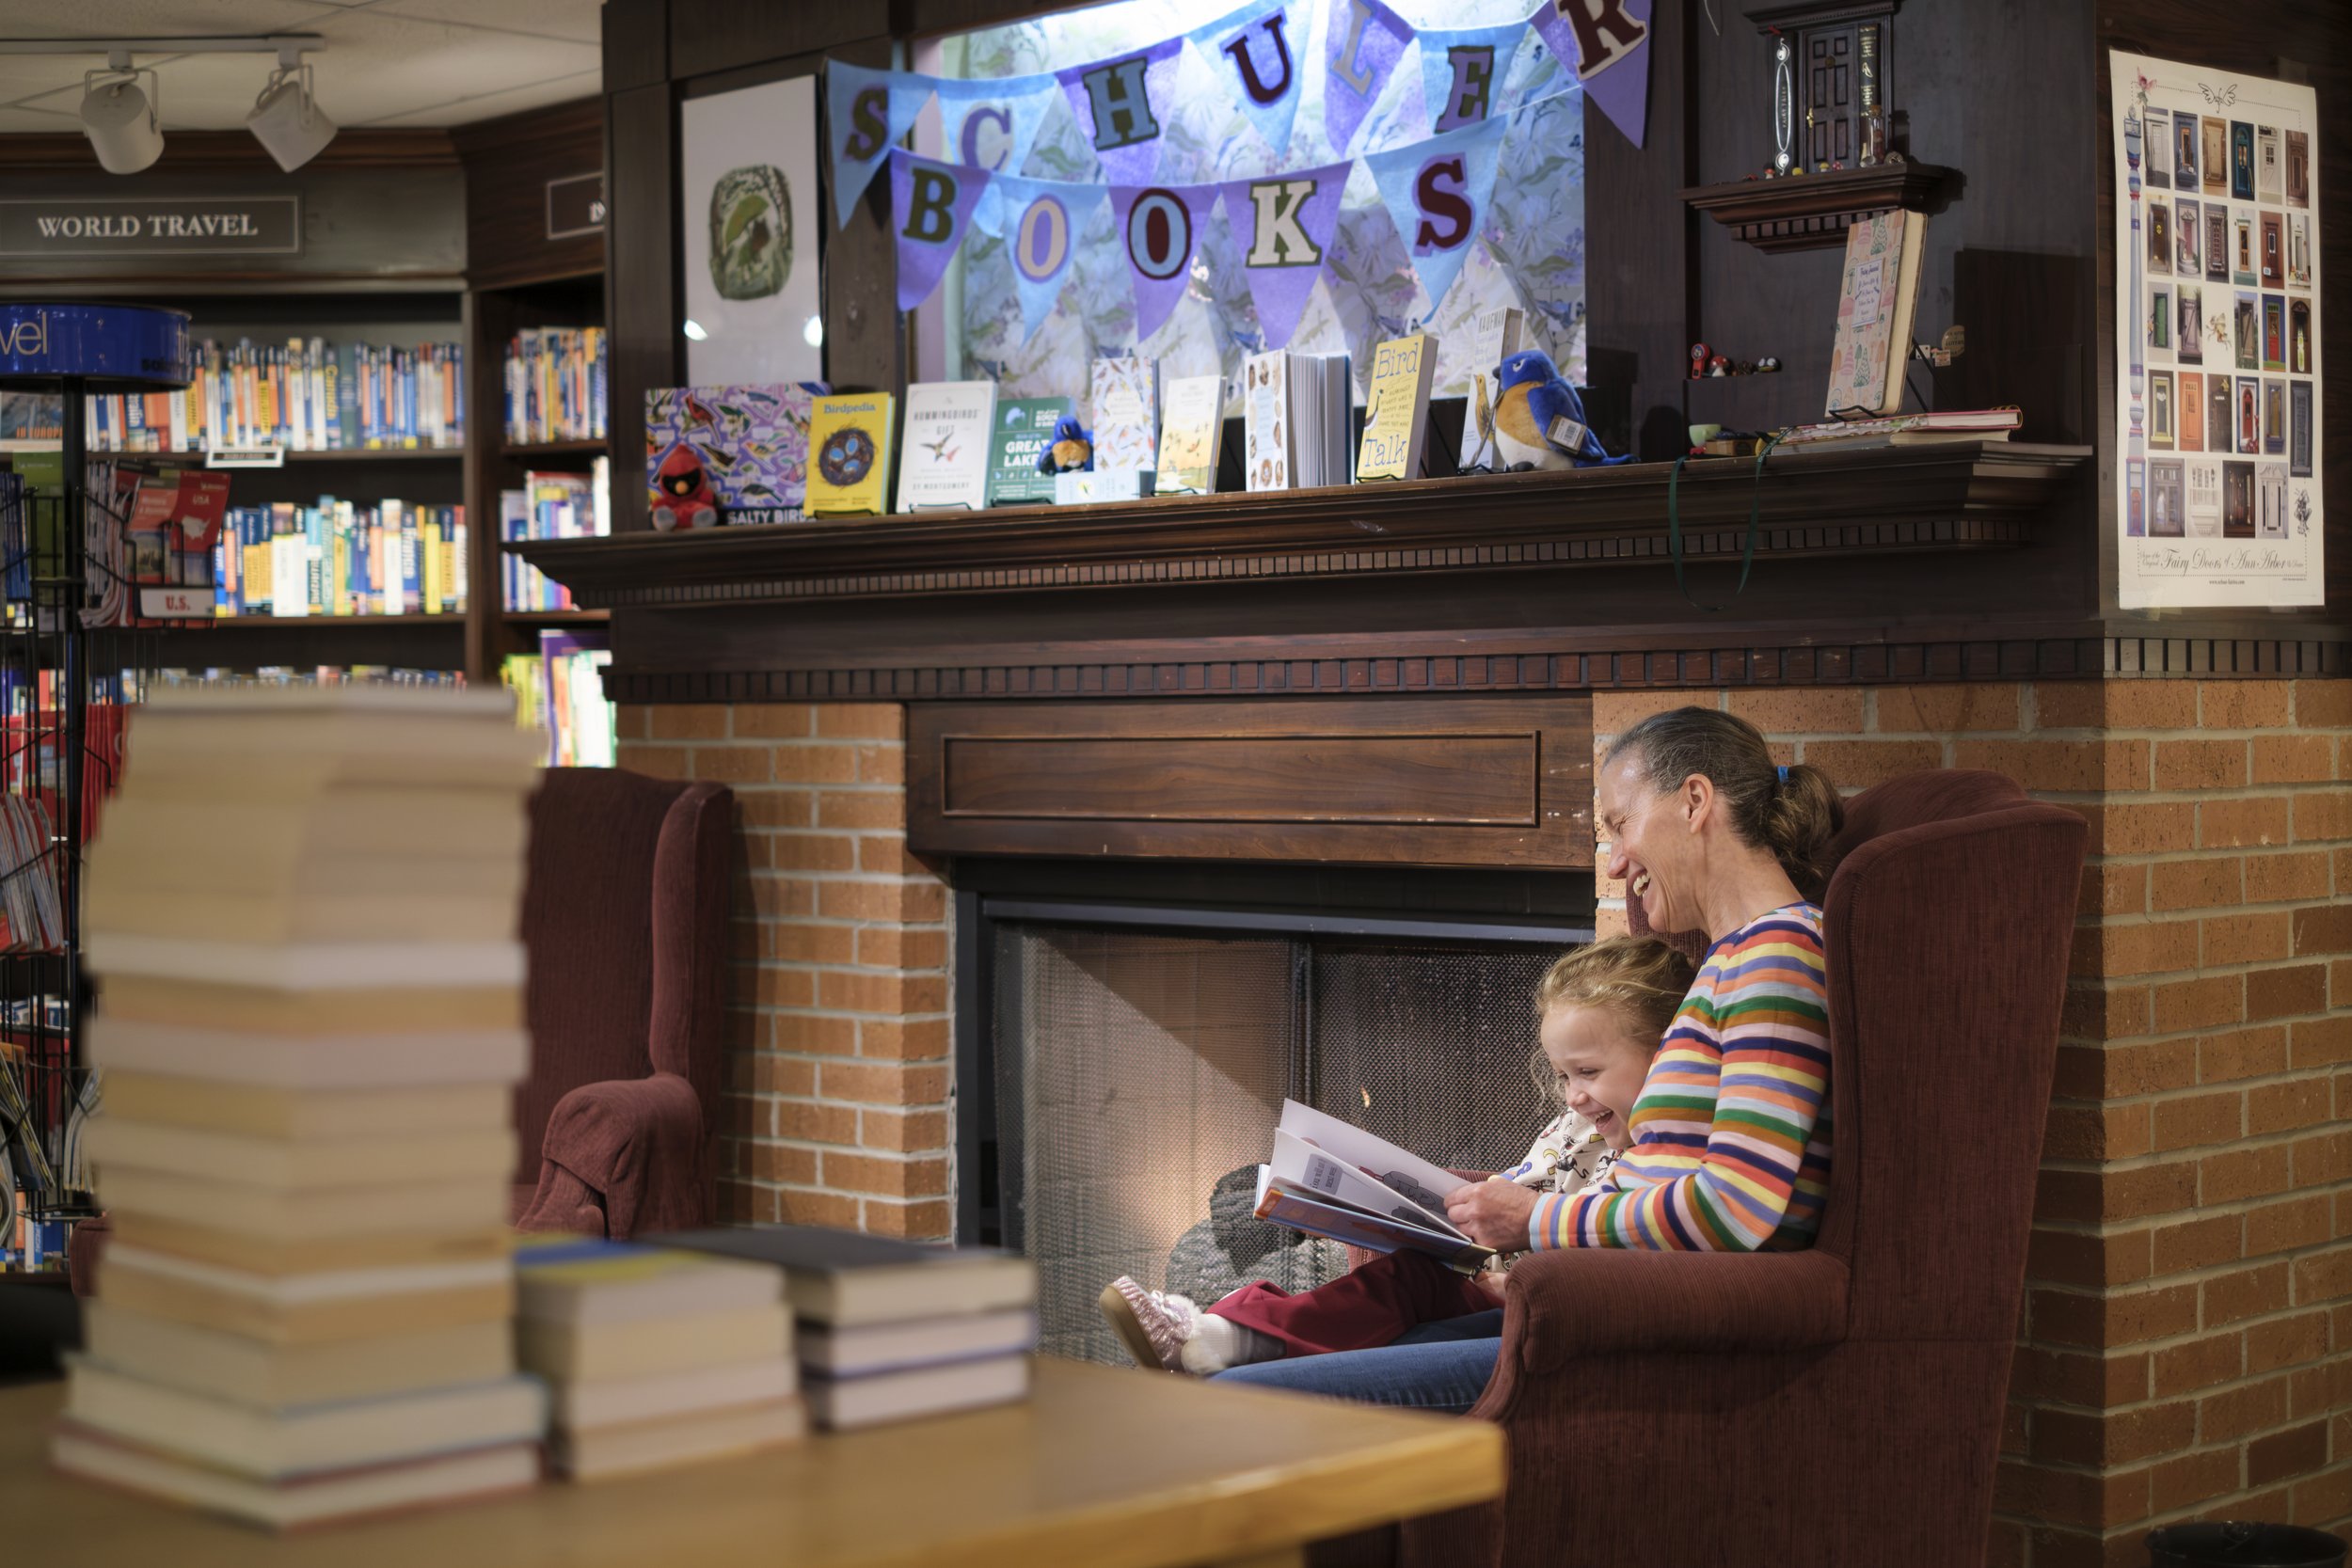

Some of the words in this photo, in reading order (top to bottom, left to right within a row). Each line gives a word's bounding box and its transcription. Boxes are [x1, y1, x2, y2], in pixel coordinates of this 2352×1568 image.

[38, 215, 141, 237] WORLD
[147, 214, 259, 236] TRAVEL
[902, 151, 1473, 282] BOOKS
[1375, 342, 1419, 379] Bird
[823, 403, 875, 415] Birdpedia
[16, 425, 26, 439] IN
[1004, 453, 1040, 467] LAKE
[1364, 435, 1406, 467] Talk
[728, 510, 770, 525] SALTY
[773, 509, 817, 523] BIRD
[2161, 548, 2189, 576] Fairy
[2192, 547, 2221, 569] Doors
[2232, 548, 2256, 570] Ann
[2256, 548, 2286, 569] Arbor
[166, 595, 191, 611] U.S.
